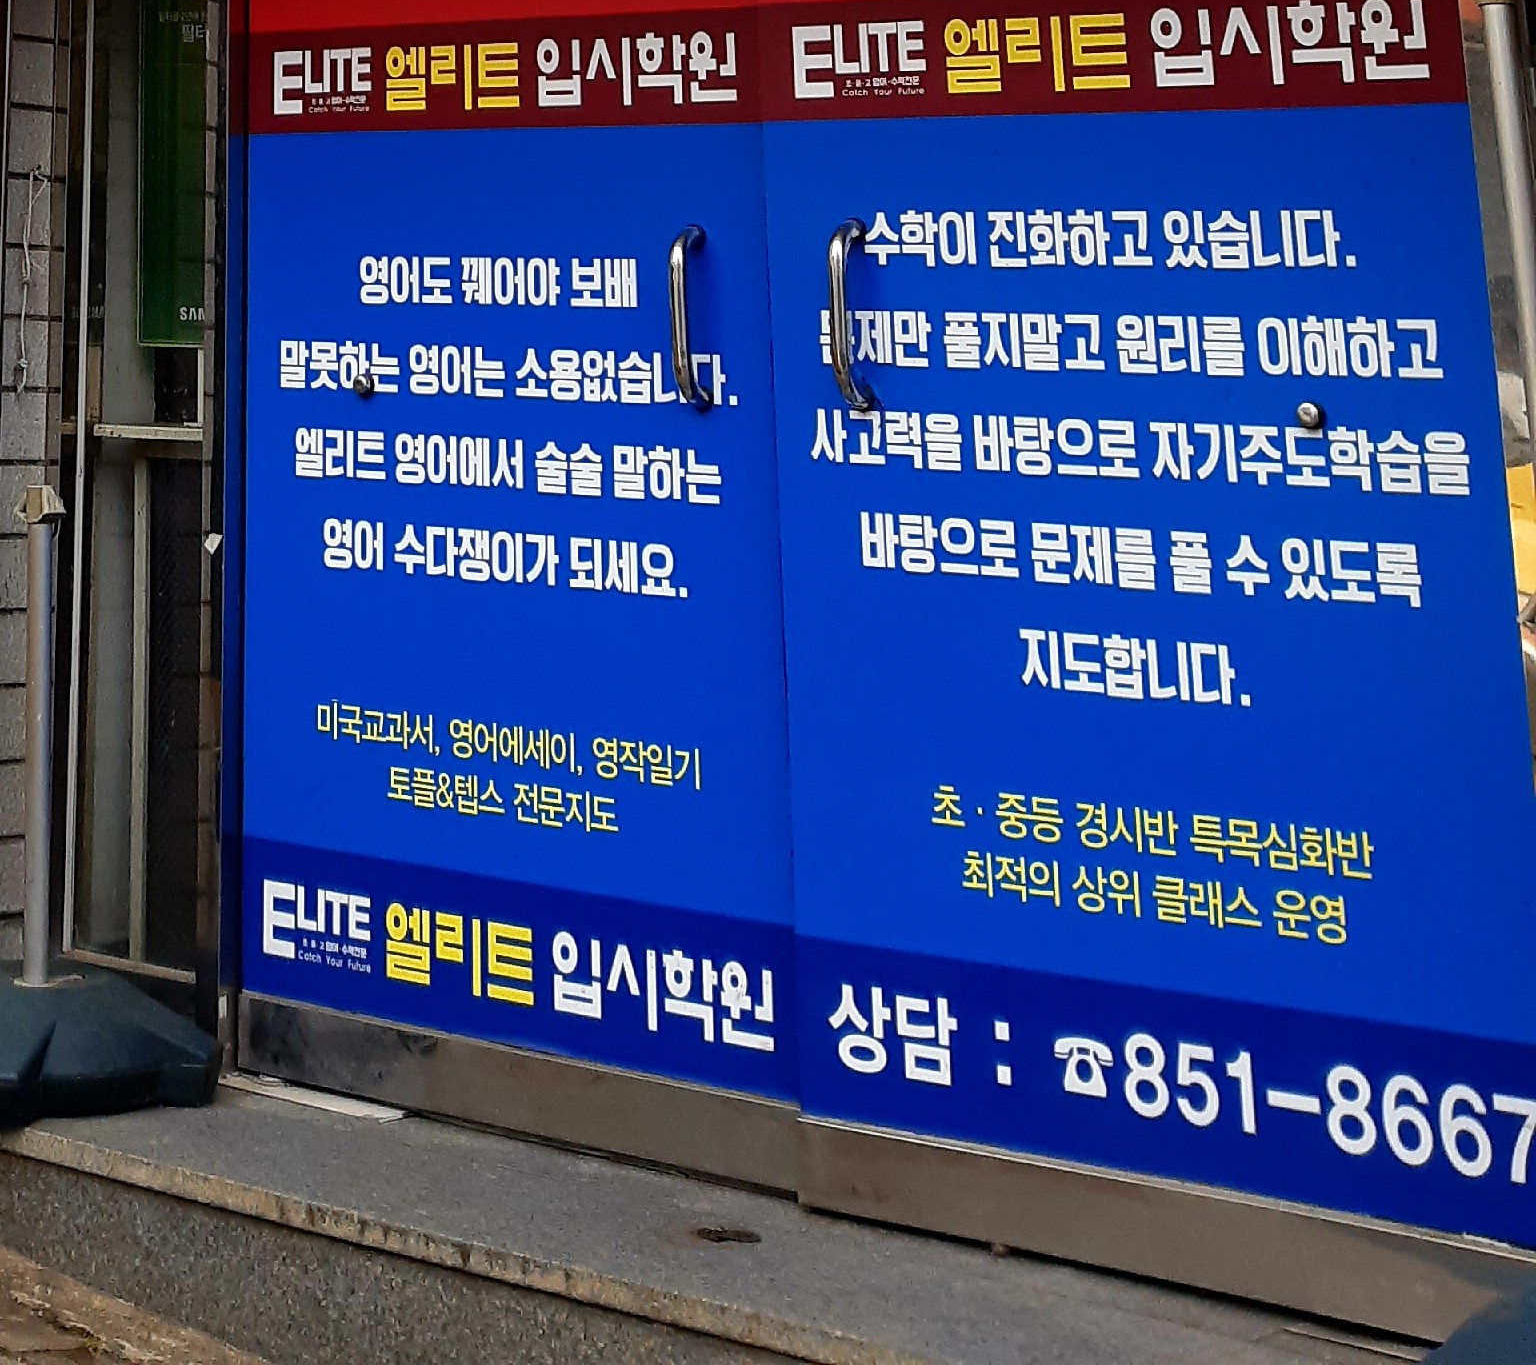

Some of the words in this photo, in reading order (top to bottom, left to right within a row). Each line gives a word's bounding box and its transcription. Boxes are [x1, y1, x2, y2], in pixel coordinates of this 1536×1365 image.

[273, 46, 372, 116] ELITE
[385, 41, 520, 111] 엘리트
[536, 30, 738, 108] 입시학원
[792, 20, 927, 99] ELITE
[944, 12, 1131, 94] 엘리트
[841, 89, 869, 97] Catch
[873, 88, 893, 96] Your
[864, 211, 978, 268] 수학이
[987, 210, 1154, 269] 진화하고
[1164, 208, 1357, 270] 있습니다.
[359, 255, 452, 306] 영어도
[461, 256, 561, 308] 꿰어야
[570, 258, 638, 308] 보배
[280, 339, 400, 394] 말못하는
[409, 343, 504, 398] 영어는
[942, 311, 1106, 372] 풀지말고
[1116, 315, 1246, 378] 원리를
[1258, 315, 1445, 380] 이해하고
[294, 427, 386, 481] 엘리트
[394, 432, 524, 489] 영어에서
[534, 441, 603, 497] 술술
[613, 443, 722, 505] 말하는
[810, 407, 963, 472] 사고력을
[973, 414, 1140, 478] 바탕으로
[1149, 420, 1470, 497] 자기주도학습을
[322, 518, 384, 571] 영어
[393, 523, 560, 587] 수다쟁이가
[569, 537, 689, 599] 되세요.
[859, 510, 1020, 579] 바탕으로
[1031, 521, 1156, 591] 문제를
[1170, 530, 1212, 594] 풀
[1226, 534, 1271, 596] 수
[1282, 536, 1422, 609] 있도록
[1019, 627, 1253, 707] 지도합니다.
[316, 698, 441, 756] 미국교과서,
[449, 717, 584, 776] 영어에세이,
[592, 736, 703, 790] 영작일기
[387, 765, 505, 817] 토플&텝스
[513, 779, 619, 833] 전문지도
[1075, 801, 1179, 858] 경시반
[1188, 812, 1374, 880] 특목심화반
[962, 849, 1061, 907] 최적의
[1071, 864, 1141, 917] 상위
[1152, 876, 1262, 929] 클래스
[1272, 888, 1348, 945] 운영
[263, 878, 371, 959] ELITE
[385, 901, 534, 1006] 엘리트
[552, 930, 775, 1052] 입시학원
[828, 984, 957, 1087] 상담
[1124, 1033, 1536, 1184] 851-8667
